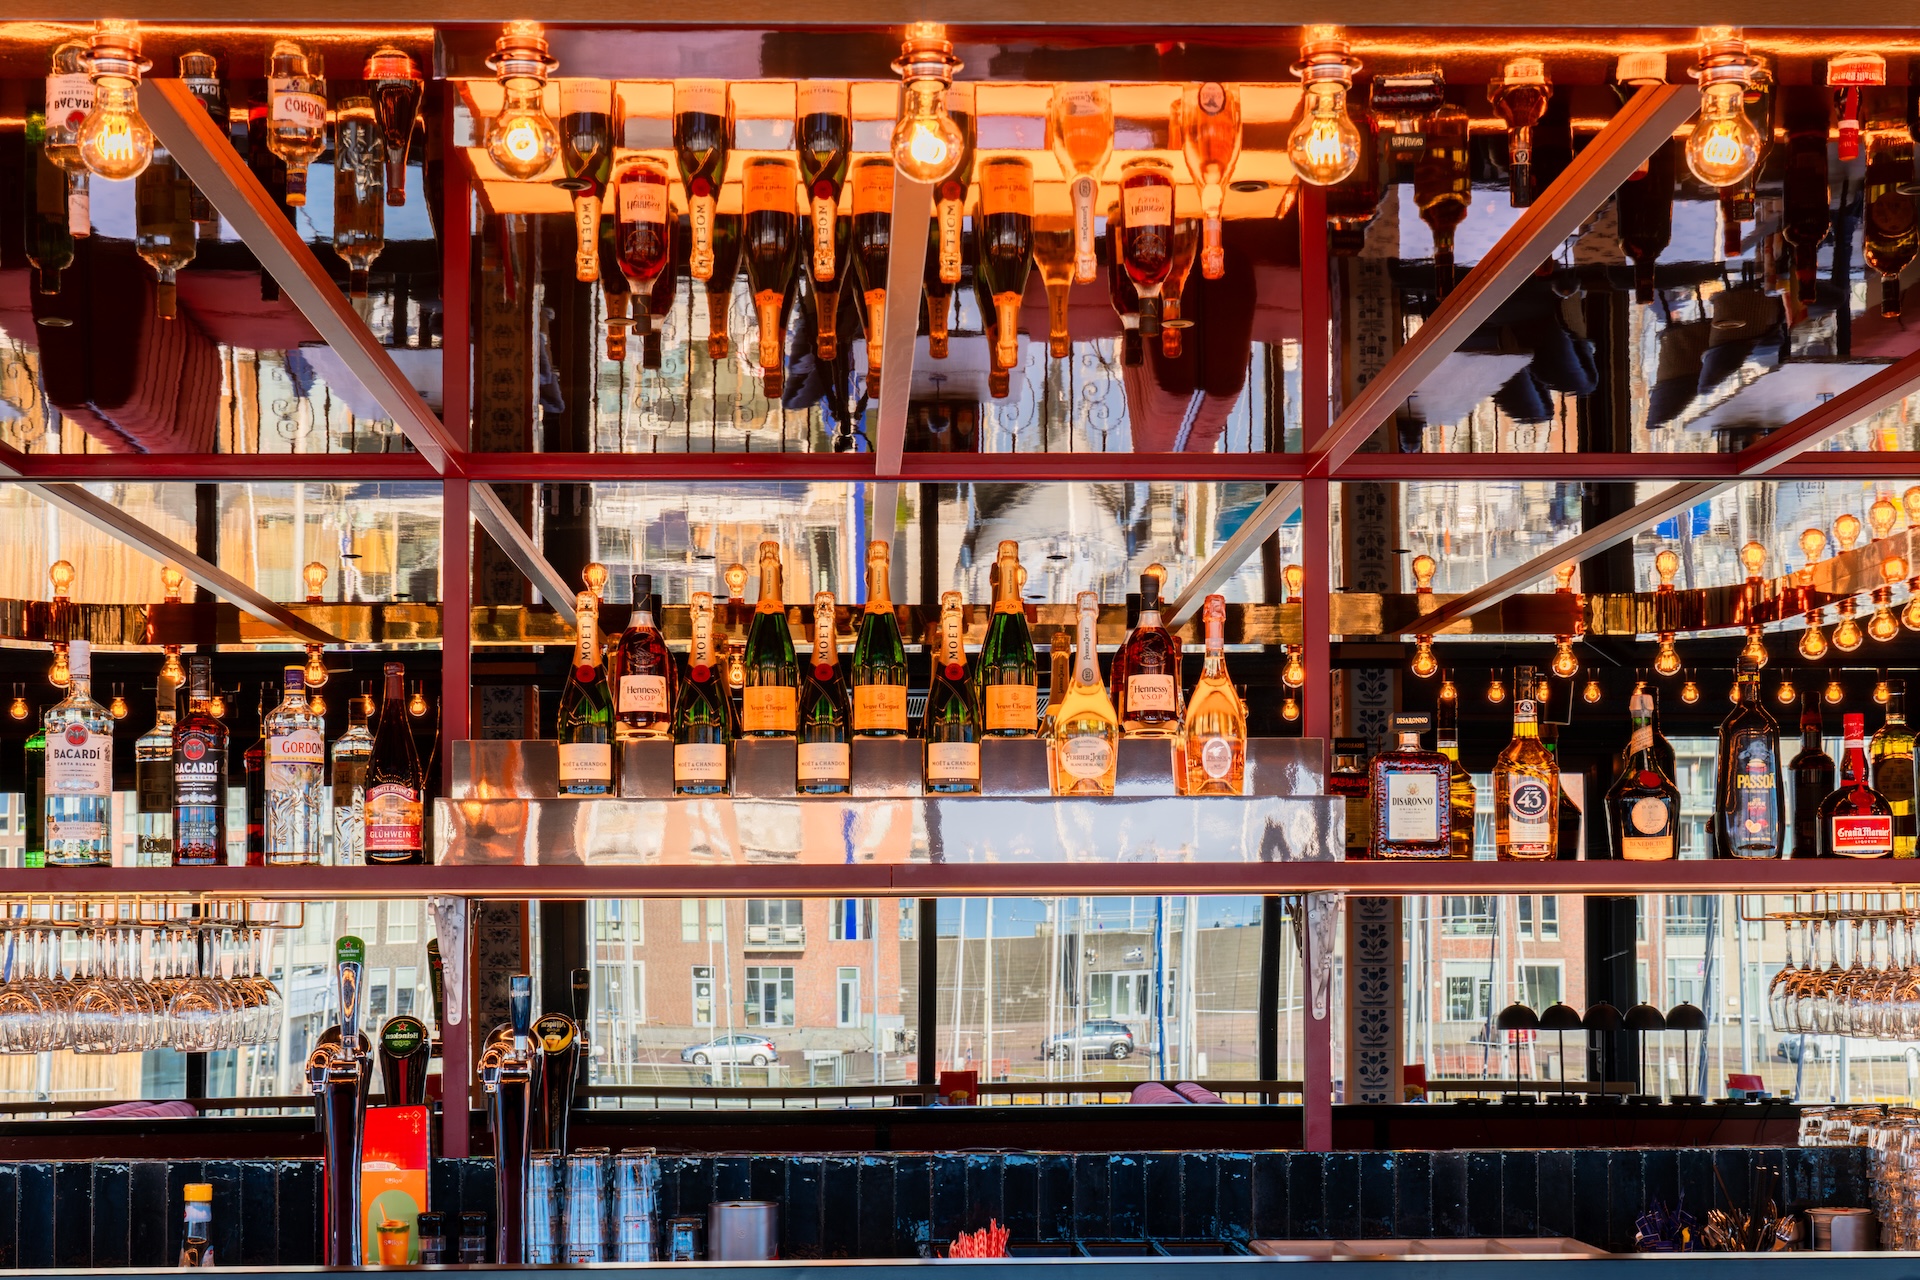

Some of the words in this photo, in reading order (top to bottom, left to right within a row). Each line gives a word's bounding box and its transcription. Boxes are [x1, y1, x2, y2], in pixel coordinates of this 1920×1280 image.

[627, 685, 661, 696] Hennessy
[1134, 685, 1168, 694] Hennessy
[54, 747, 100, 759] BACARDÍ
[175, 761, 218, 773] BACARDÍ
[1392, 797, 1433, 806] DISARONNO
[1516, 790, 1542, 808] 43
[370, 830, 411, 838] GLÜHWEIN
